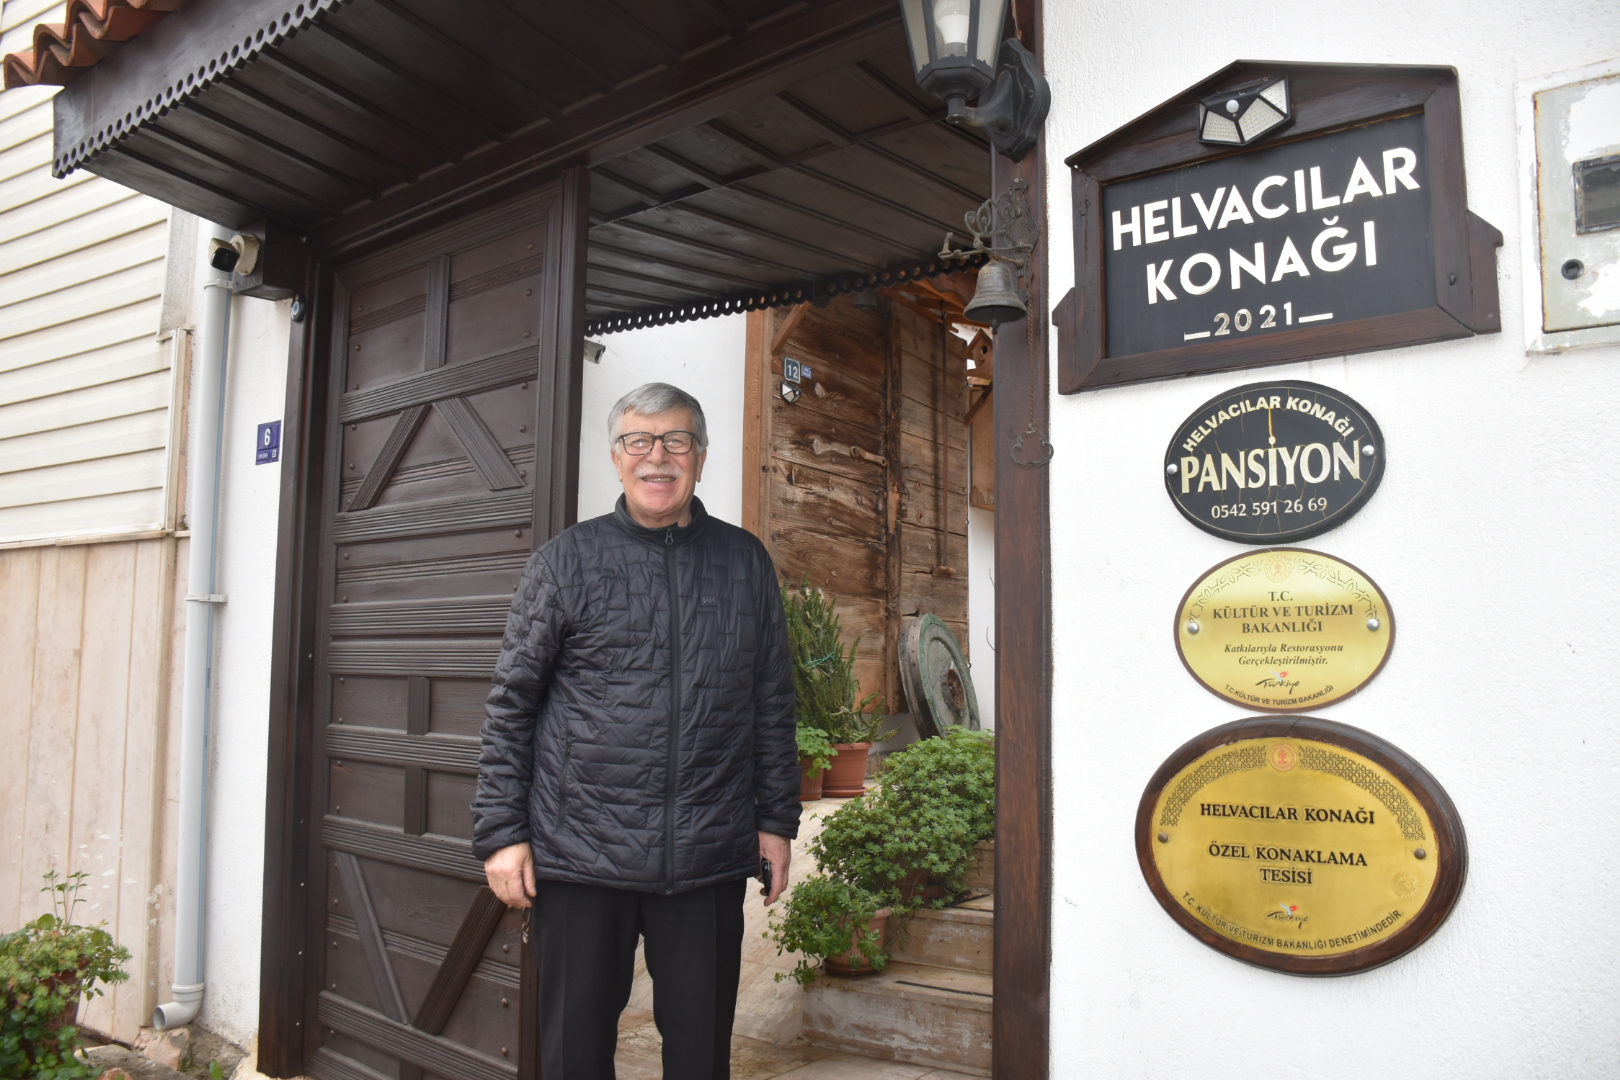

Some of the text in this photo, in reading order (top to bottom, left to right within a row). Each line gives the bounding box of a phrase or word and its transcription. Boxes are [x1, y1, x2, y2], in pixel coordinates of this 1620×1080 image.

[1111, 147, 1420, 251] HELVACILAR
[1146, 215, 1377, 304] KONAĞI
[787, 364, 798, 379] 12
[1182, 396, 1355, 452] HELVACILAR KONAĞI
[264, 428, 271, 446] 6
[1180, 437, 1361, 494] PANSİYON
[1211, 497, 1328, 519] 0542 591 26 69
[1268, 591, 1294, 602] T.C.
[1212, 602, 1354, 619] KÜLTÜR VE TURİZM
[1241, 618, 1323, 634] BAKANLIĞI
[1224, 643, 1343, 655] Katkılarıyla Restorasyonu
[1238, 655, 1328, 668] Gerçekleştirilmiştir.
[1255, 678, 1300, 695] Türkiye
[1272, 696, 1298, 706] TURİZM
[1298, 684, 1335, 703] BAKANLIĞI
[1200, 803, 1375, 824] HELVACILAR KONAĞI
[1208, 840, 1368, 866] ÖZEL KONAKLAMA
[1260, 866, 1313, 884] TESİSİ
[1182, 891, 1195, 908] T.C.
[1228, 925, 1240, 936] VE
[1276, 938, 1328, 950] BAKANLIĞI
[1265, 911, 1309, 929] Türkiye
